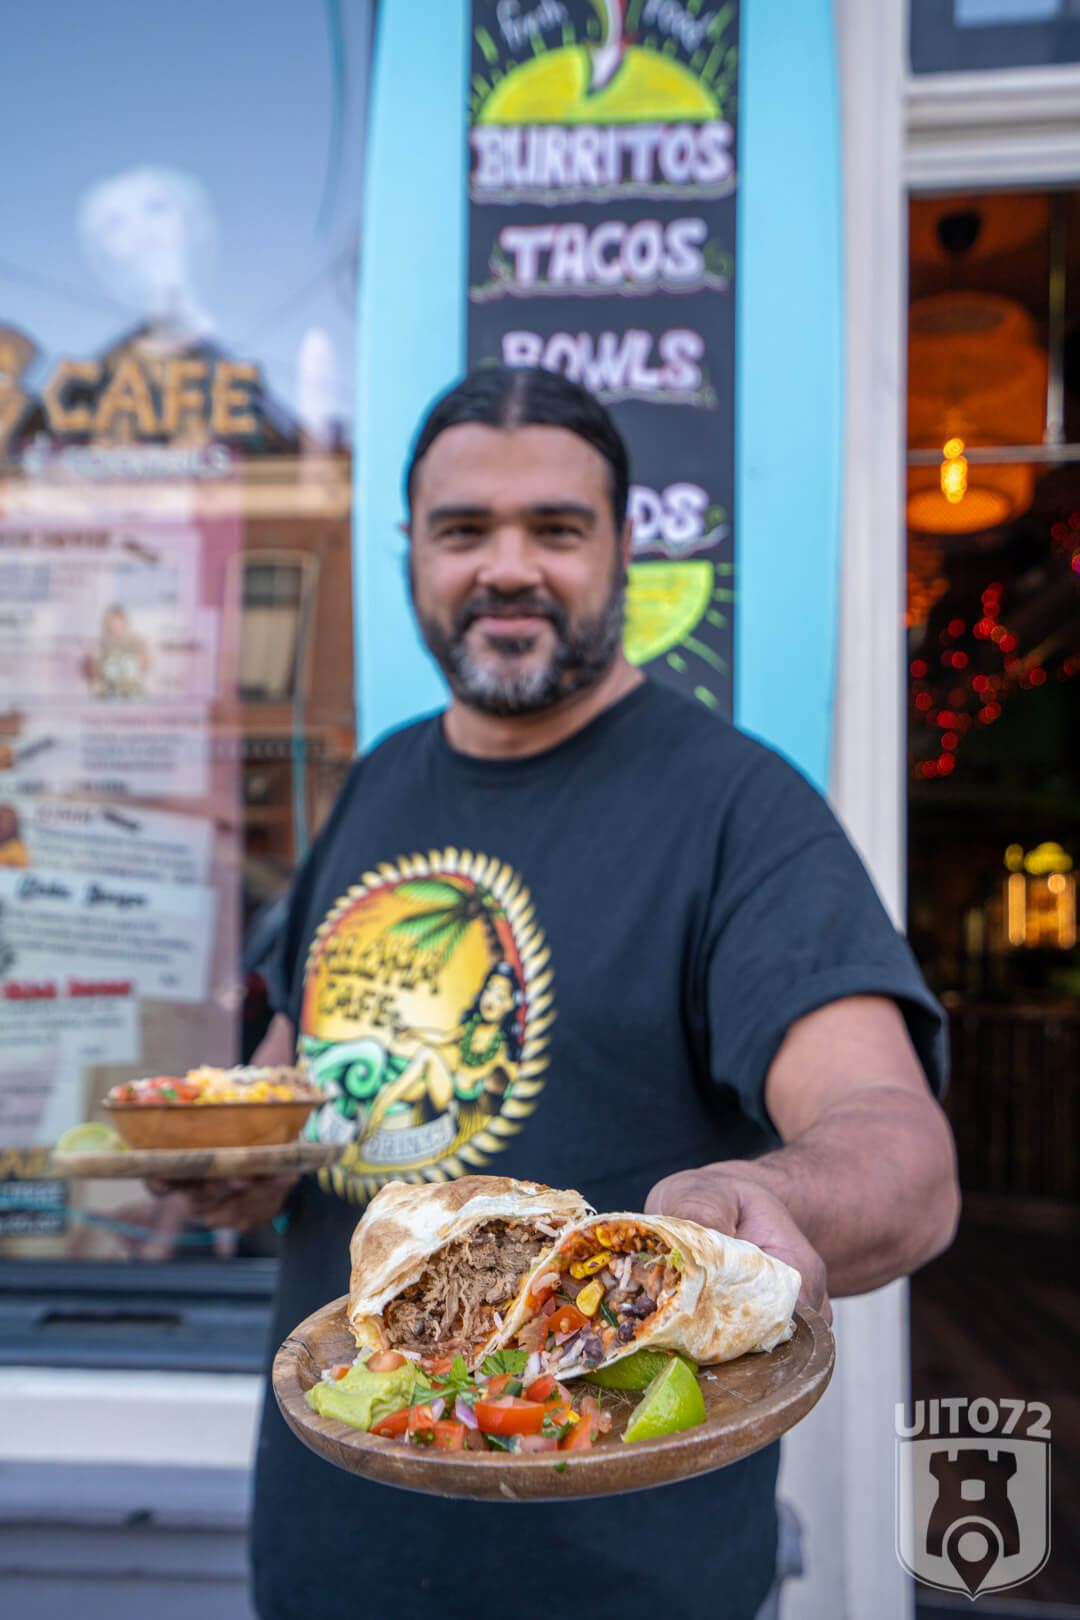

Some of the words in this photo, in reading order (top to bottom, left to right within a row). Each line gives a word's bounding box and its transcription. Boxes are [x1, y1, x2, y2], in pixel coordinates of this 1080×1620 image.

[470, 121, 734, 187] BURRITOS
[499, 217, 707, 286] TACOS
[502, 328, 703, 389] BOWLS
